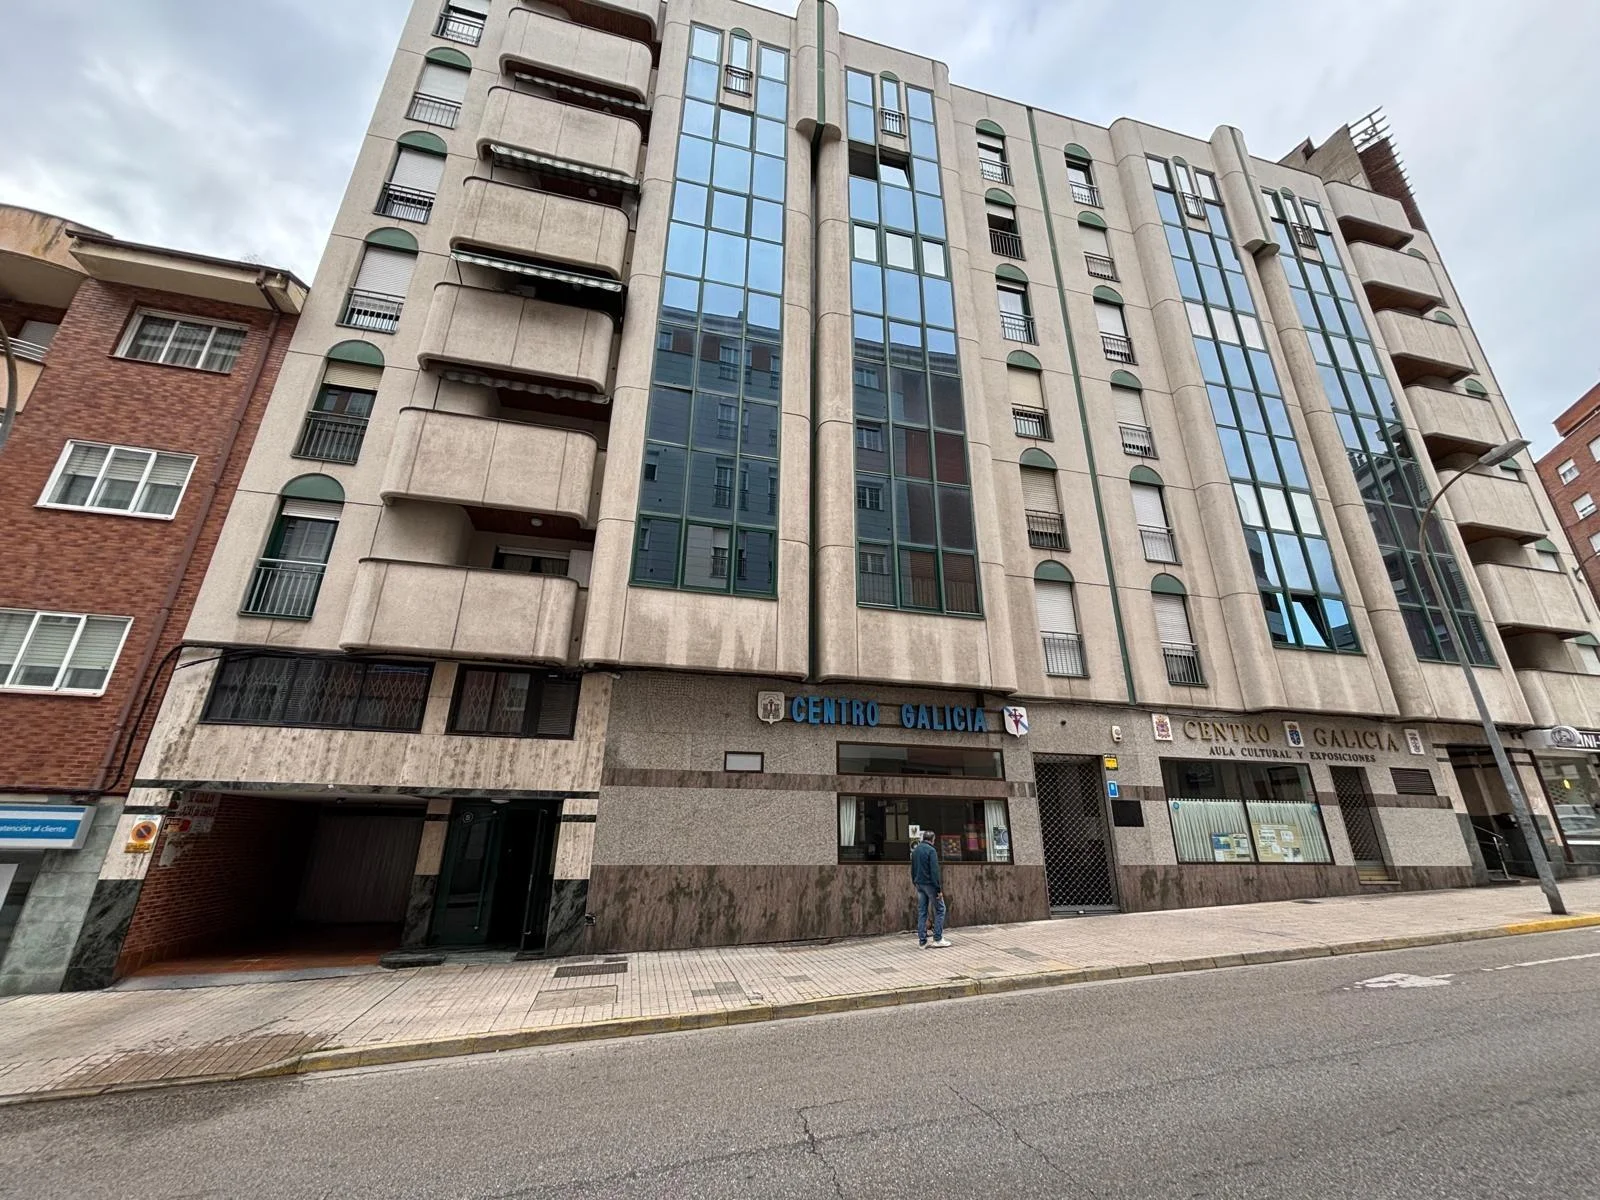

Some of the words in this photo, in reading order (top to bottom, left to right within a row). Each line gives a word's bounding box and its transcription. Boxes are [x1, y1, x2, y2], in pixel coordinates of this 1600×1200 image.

[790, 696, 881, 727] CENTRO
[901, 703, 989, 732] GALICIA
[1183, 720, 1271, 743] CENTRO
[1313, 727, 1400, 752] GALICIA
[1209, 746, 1236, 757] AULA
[1240, 747, 1292, 759] CULTURAL
[1296, 750, 1303, 759] Y
[1310, 751, 1377, 763] EXPOSICIONES
[32, 824, 41, 833] al
[40, 825, 67, 833] cliente
